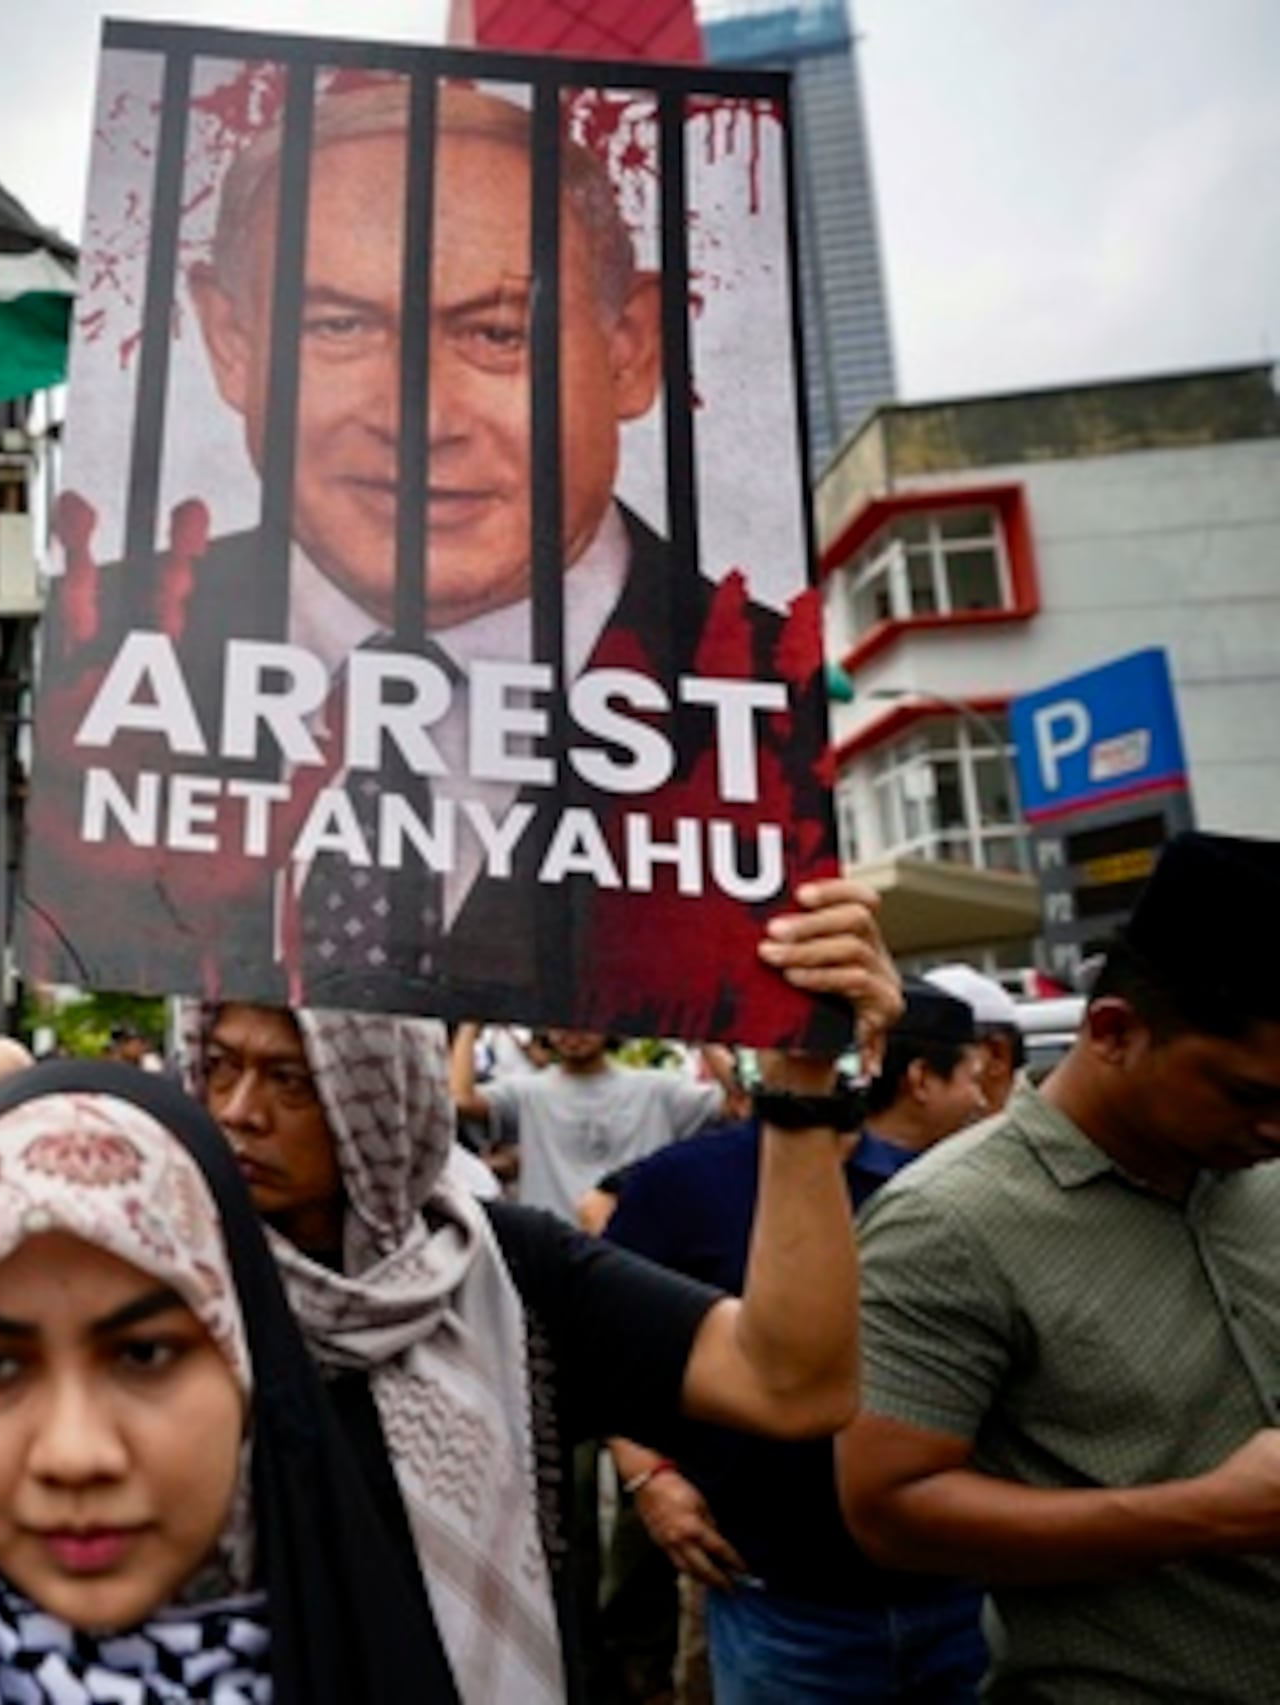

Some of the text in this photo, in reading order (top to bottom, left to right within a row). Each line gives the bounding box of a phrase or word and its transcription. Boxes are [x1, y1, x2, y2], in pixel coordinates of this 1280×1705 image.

[74, 629, 788, 803] ARREST
[1033, 699, 1091, 792] P
[82, 766, 785, 902] NETANYAHU
